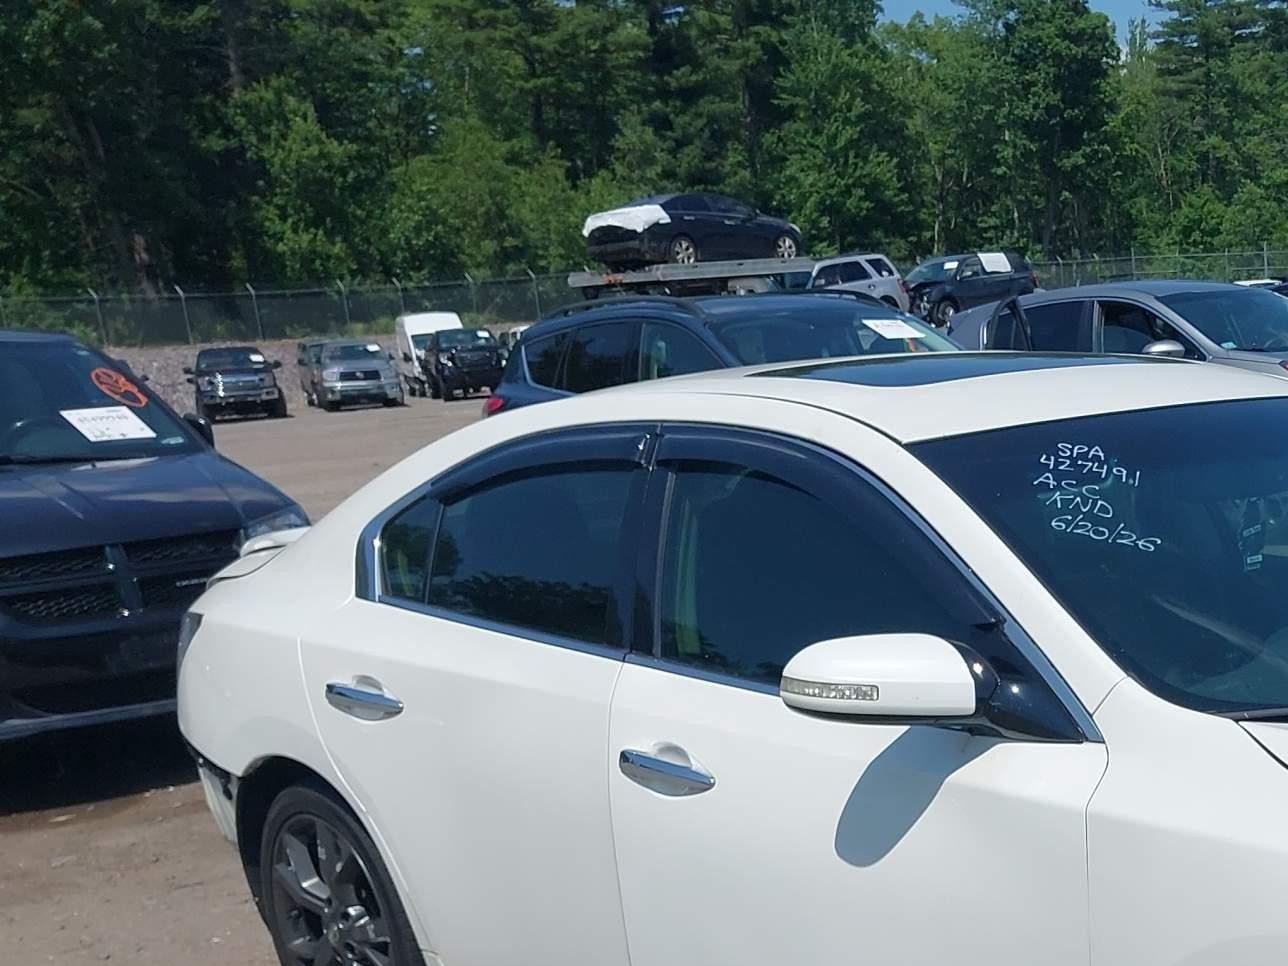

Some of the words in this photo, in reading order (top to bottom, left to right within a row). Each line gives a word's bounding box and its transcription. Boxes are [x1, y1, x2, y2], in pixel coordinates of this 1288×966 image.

[1057, 443, 1105, 460] SPA
[1033, 473, 1100, 499] ACC
[1051, 514, 1161, 552] 6/20/26
